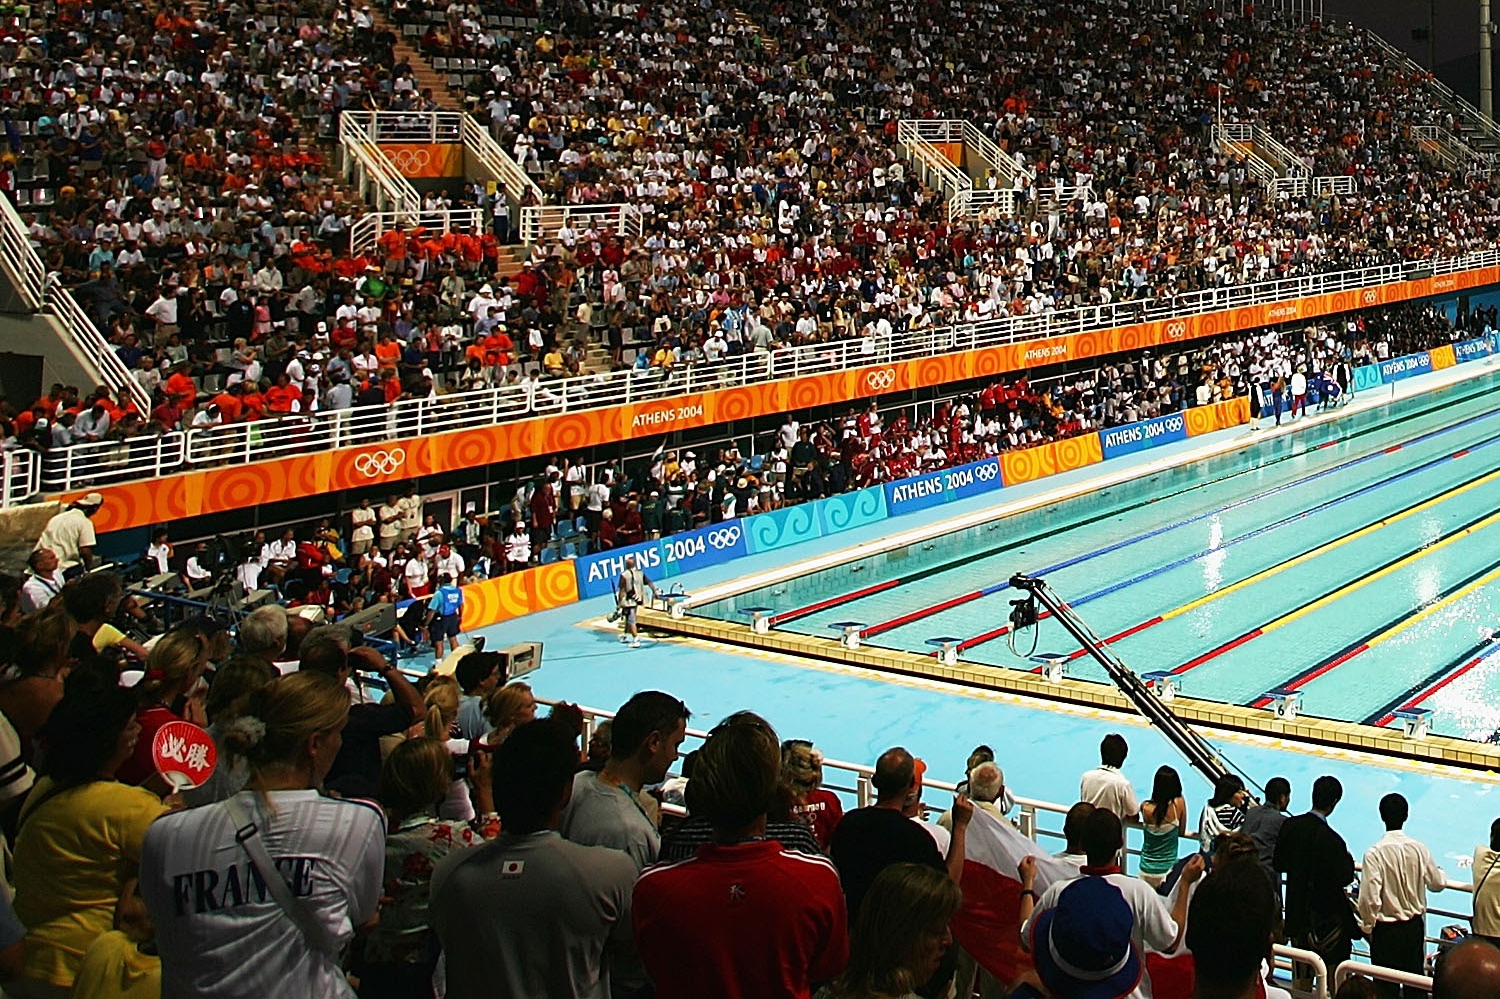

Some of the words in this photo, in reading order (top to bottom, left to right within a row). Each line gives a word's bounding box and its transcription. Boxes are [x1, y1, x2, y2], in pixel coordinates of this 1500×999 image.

[1025, 347, 1050, 360] ATHENS
[1051, 345, 1067, 356] 2004
[632, 409, 675, 427] ATHENS
[677, 405, 703, 420] 2004
[1105, 427, 1142, 448] ATHENS
[1143, 422, 1164, 438] 2004
[893, 477, 942, 503] ATHENS
[944, 469, 973, 490] 2004
[664, 535, 705, 563] 2004
[843, 634, 848, 645] 2
[940, 650, 945, 661] 3
[1044, 667, 1050, 678] 4
[1157, 685, 1163, 697] 5
[1278, 704, 1285, 716] 6
[1408, 723, 1415, 735] 7
[161, 732, 211, 772] 必勝
